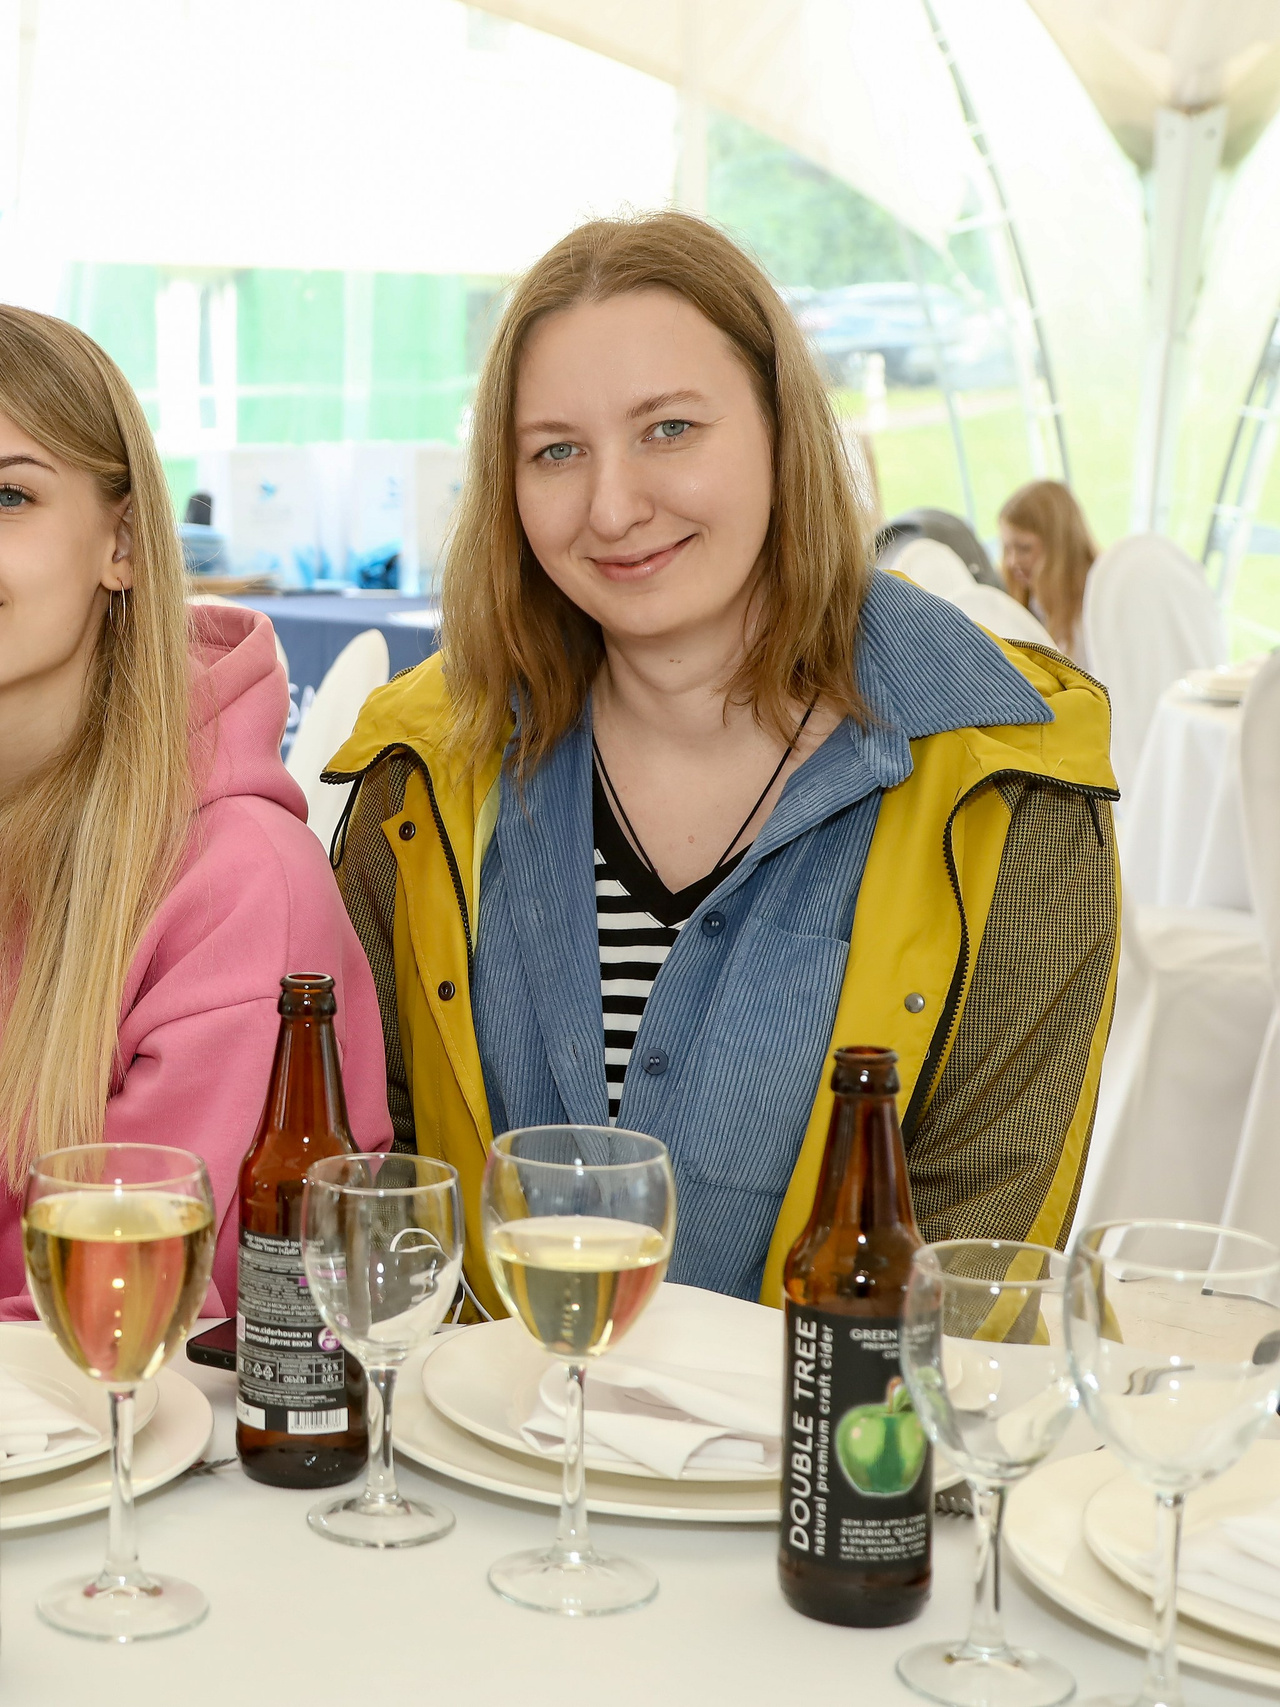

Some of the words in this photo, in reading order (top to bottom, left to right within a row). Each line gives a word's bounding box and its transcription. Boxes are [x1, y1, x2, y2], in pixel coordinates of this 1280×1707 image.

[245, 1323, 313, 1339] www.ciderhouse.ru
[818, 1324, 834, 1370] cider
[849, 1328, 898, 1341] GREEN
[793, 1316, 817, 1400] TREE
[816, 1373, 832, 1415] craft
[814, 1419, 830, 1493] premium
[789, 1410, 814, 1552] DOUBLE
[813, 1495, 827, 1556] natural
[841, 1527, 891, 1537] SUPERIOR
[893, 1522, 926, 1537] QUALITY
